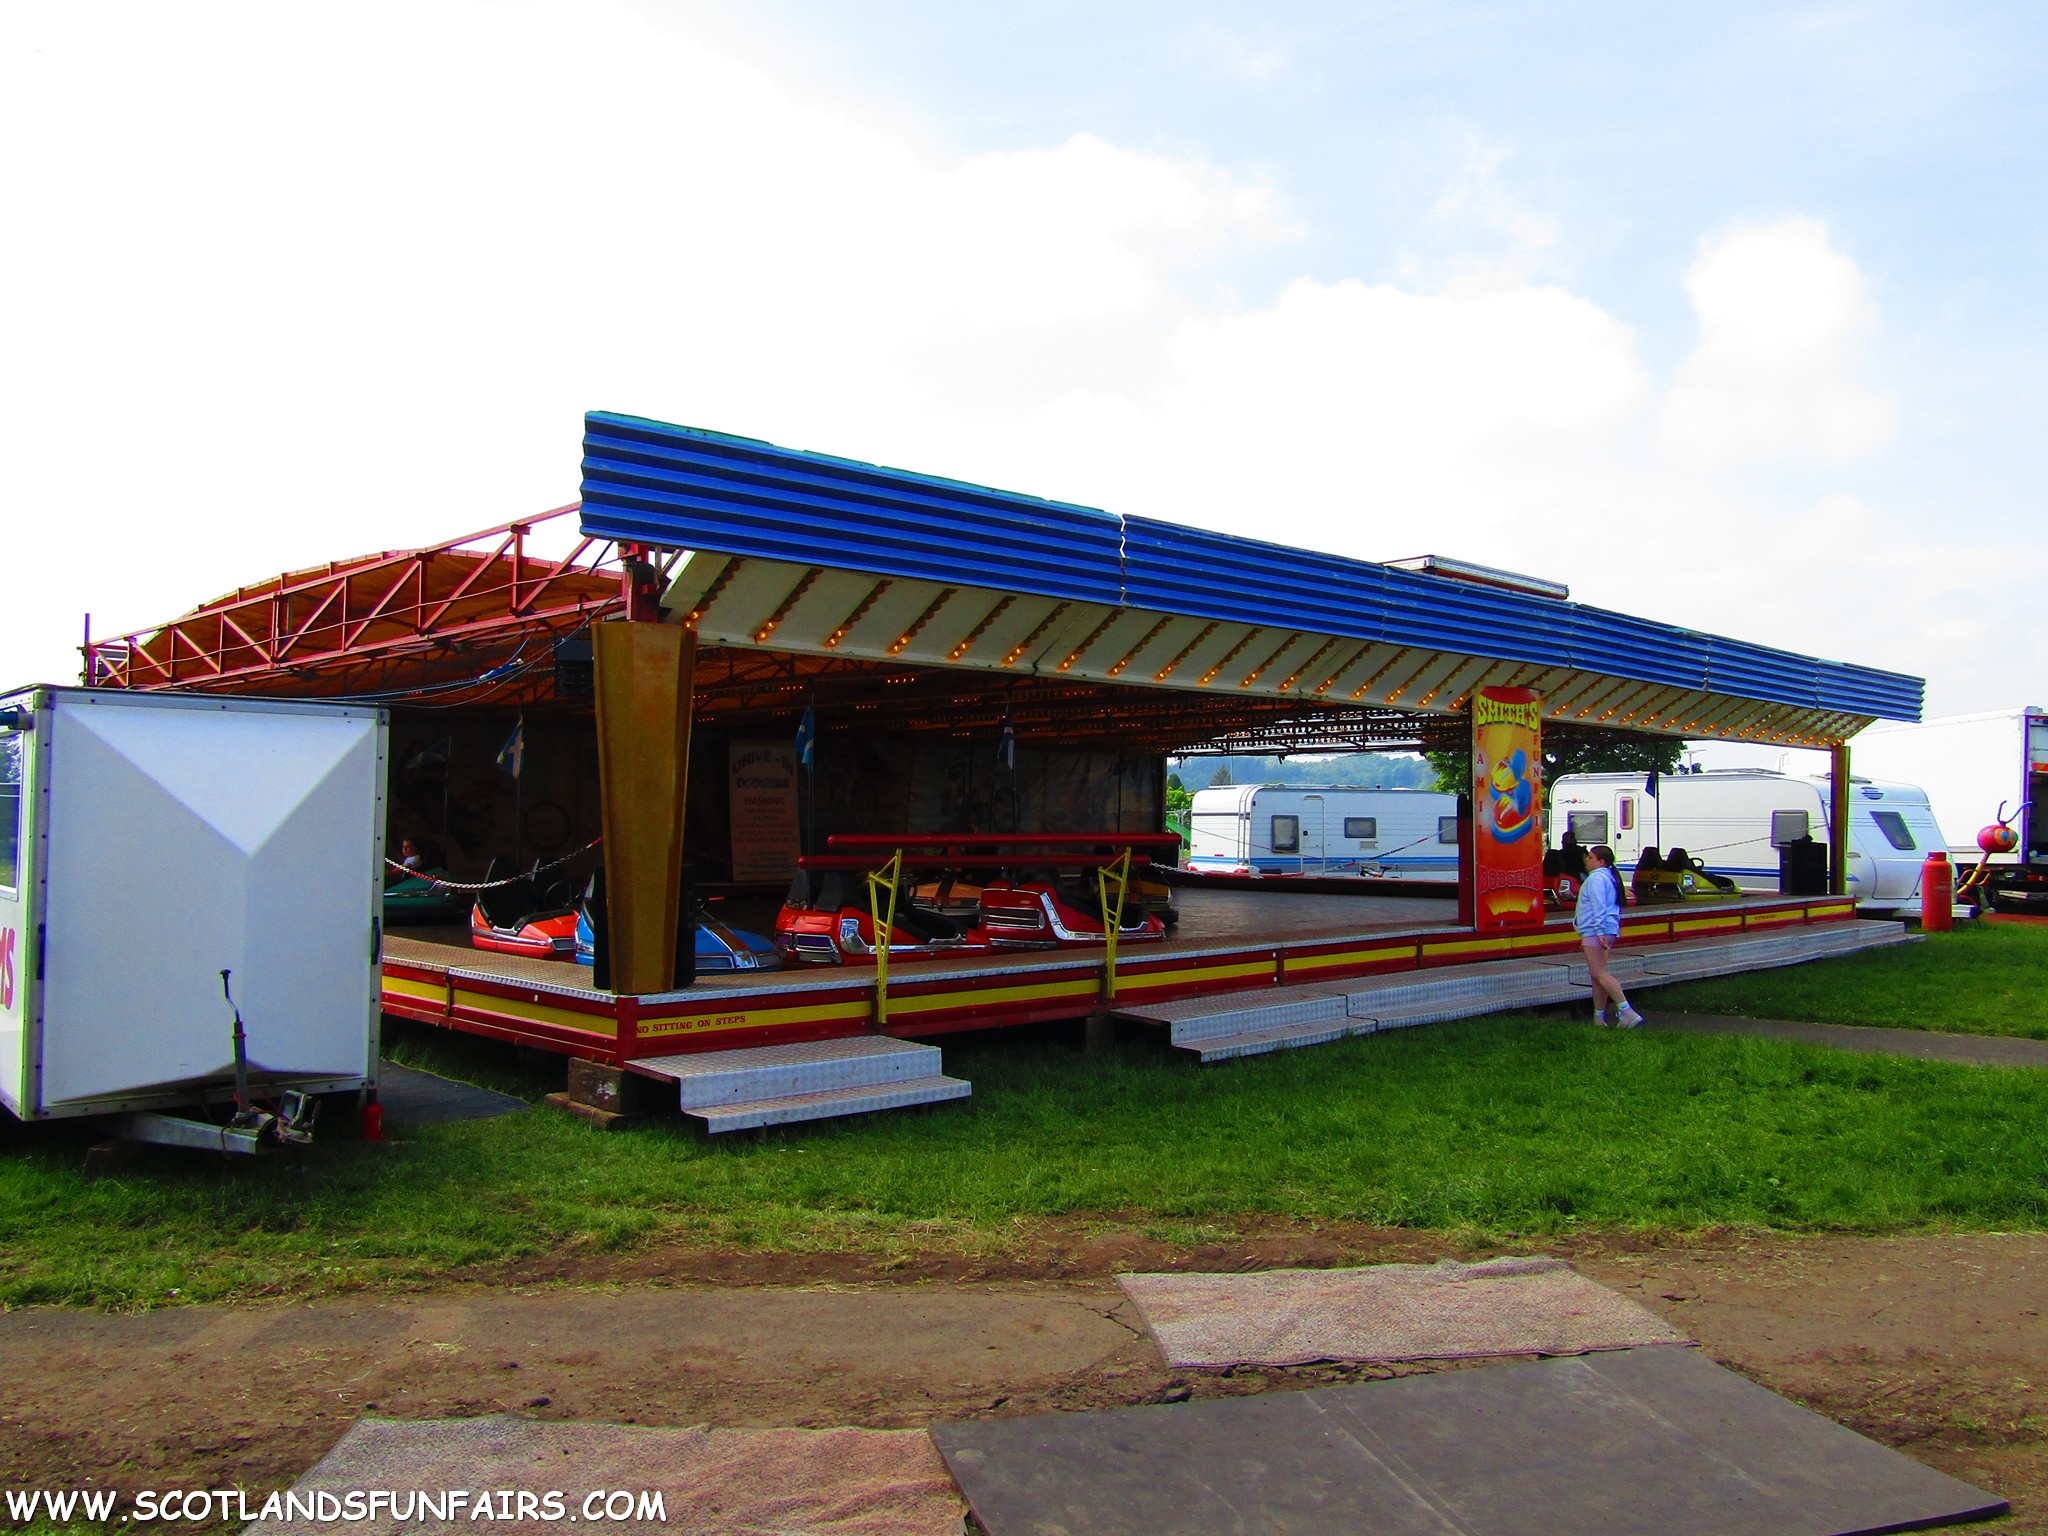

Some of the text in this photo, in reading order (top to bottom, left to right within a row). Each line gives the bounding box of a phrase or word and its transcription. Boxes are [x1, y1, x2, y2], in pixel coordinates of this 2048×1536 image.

[1477, 694, 1538, 730] SMITH'S
[732, 749, 772, 775] DRIVE
[744, 797, 786, 806] WARNING
[1479, 864, 1540, 894] DODGEMS
[653, 1022, 692, 1031] SITTING
[697, 1019, 711, 1027] ON
[715, 1016, 746, 1025] STEPS
